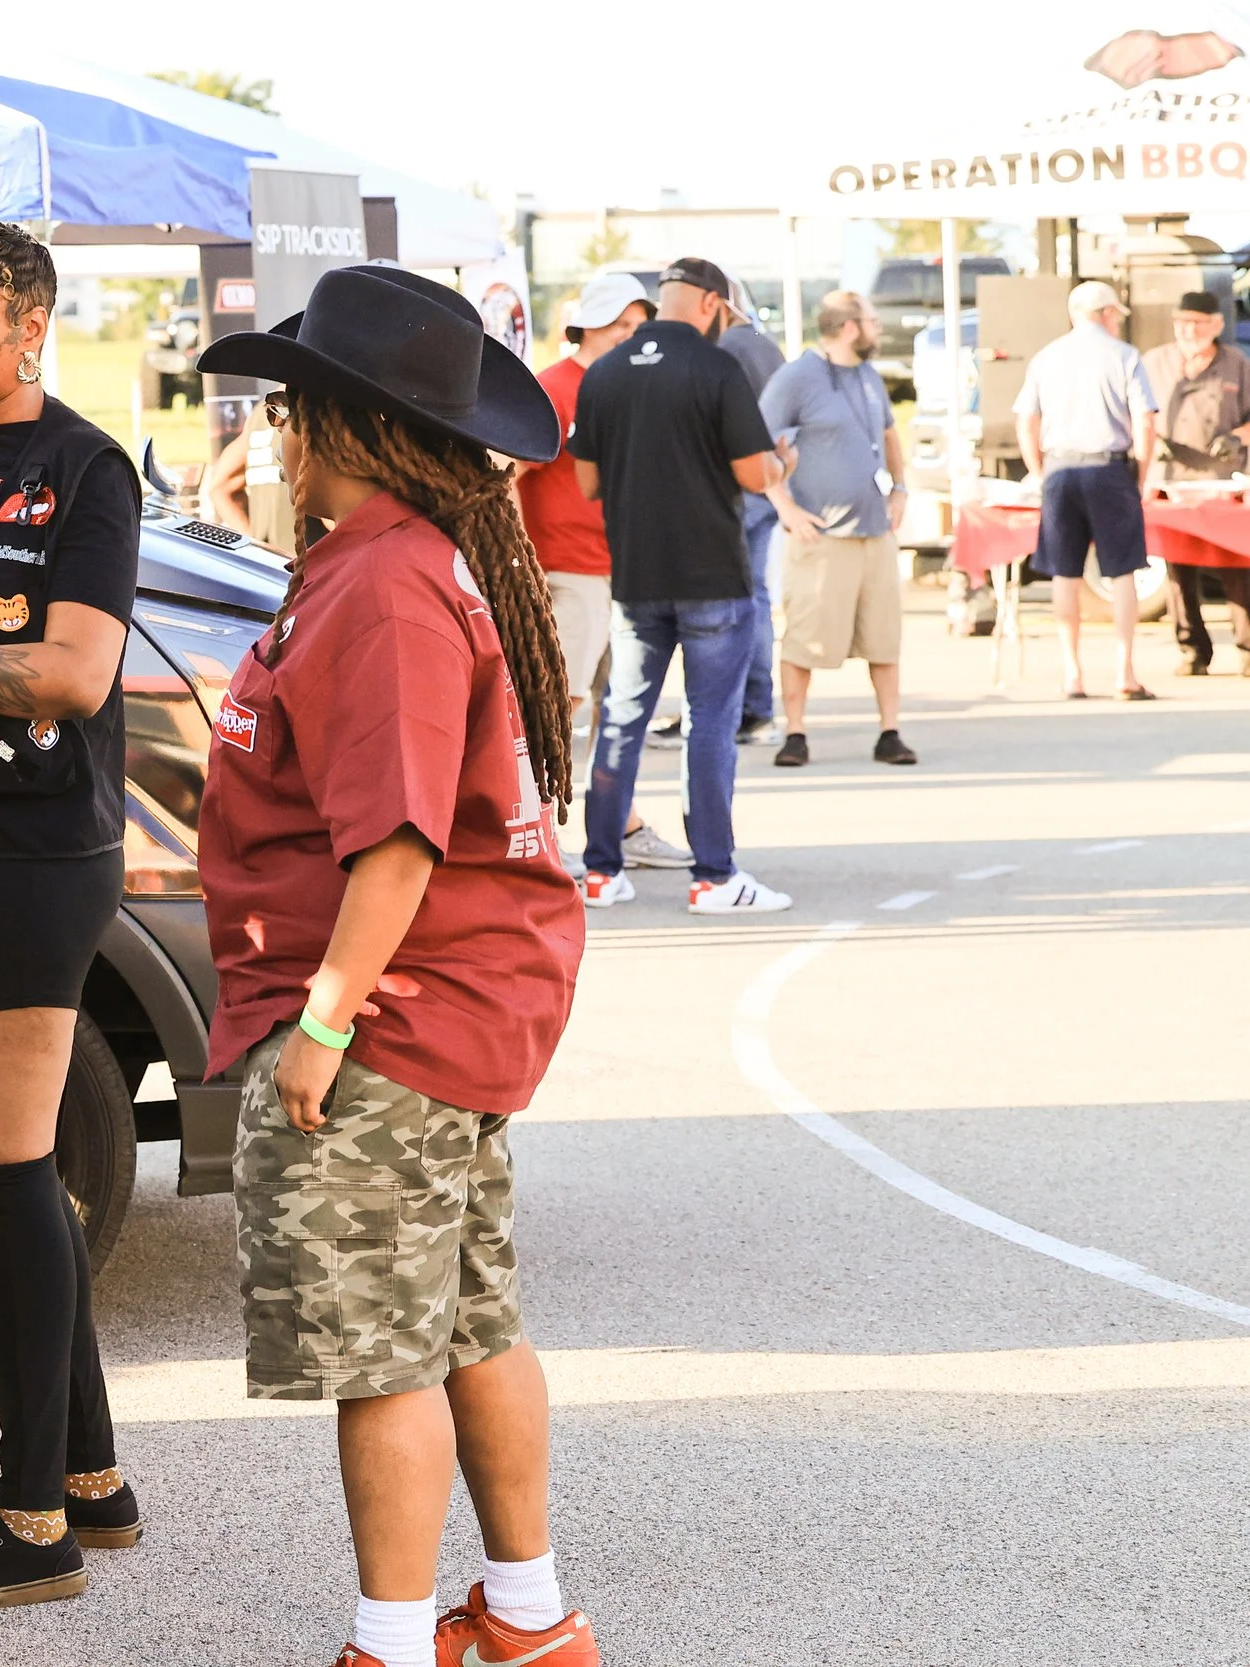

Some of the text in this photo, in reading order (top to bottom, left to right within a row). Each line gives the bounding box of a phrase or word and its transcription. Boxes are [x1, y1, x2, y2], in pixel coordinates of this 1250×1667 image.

[829, 142, 1247, 195] OPERATION BBQ
[256, 223, 363, 257] SIP TRACKSIDE
